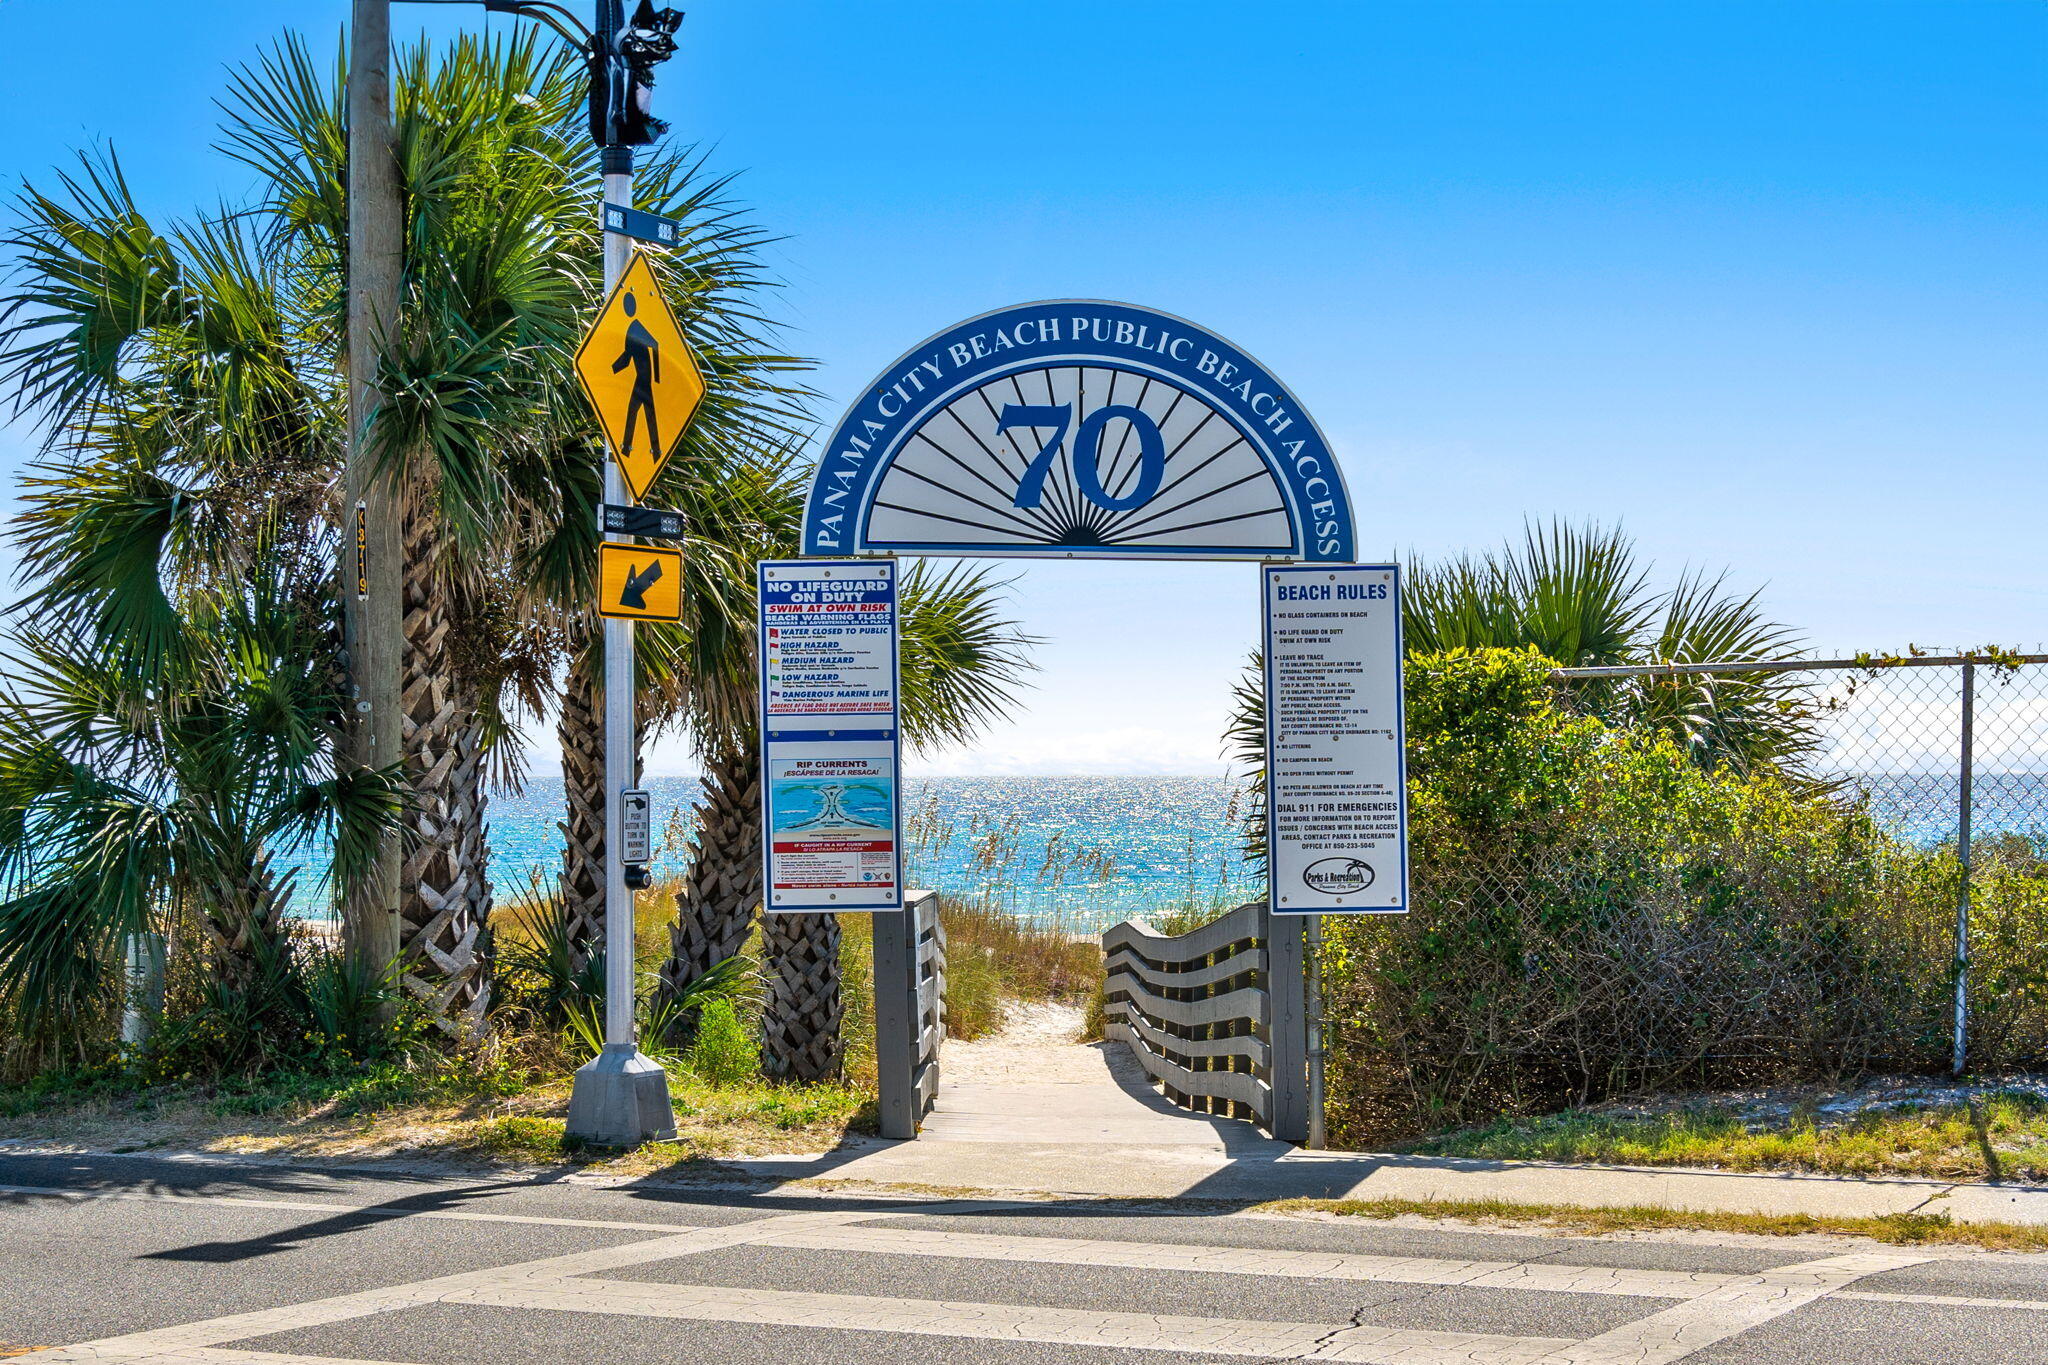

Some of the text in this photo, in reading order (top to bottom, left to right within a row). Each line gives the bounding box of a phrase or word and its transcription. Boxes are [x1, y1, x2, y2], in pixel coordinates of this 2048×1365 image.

[817, 317, 1340, 556] PANAMA CITY BEACH PUBLIC BEACH ACCESS
[996, 401, 1165, 511] 70
[767, 581, 888, 592] NO LIFEGUARD
[1278, 584, 1387, 600] BEACH RULES
[791, 592, 864, 602] ON DUTY
[1308, 873, 1360, 882] Parks & Recreation
